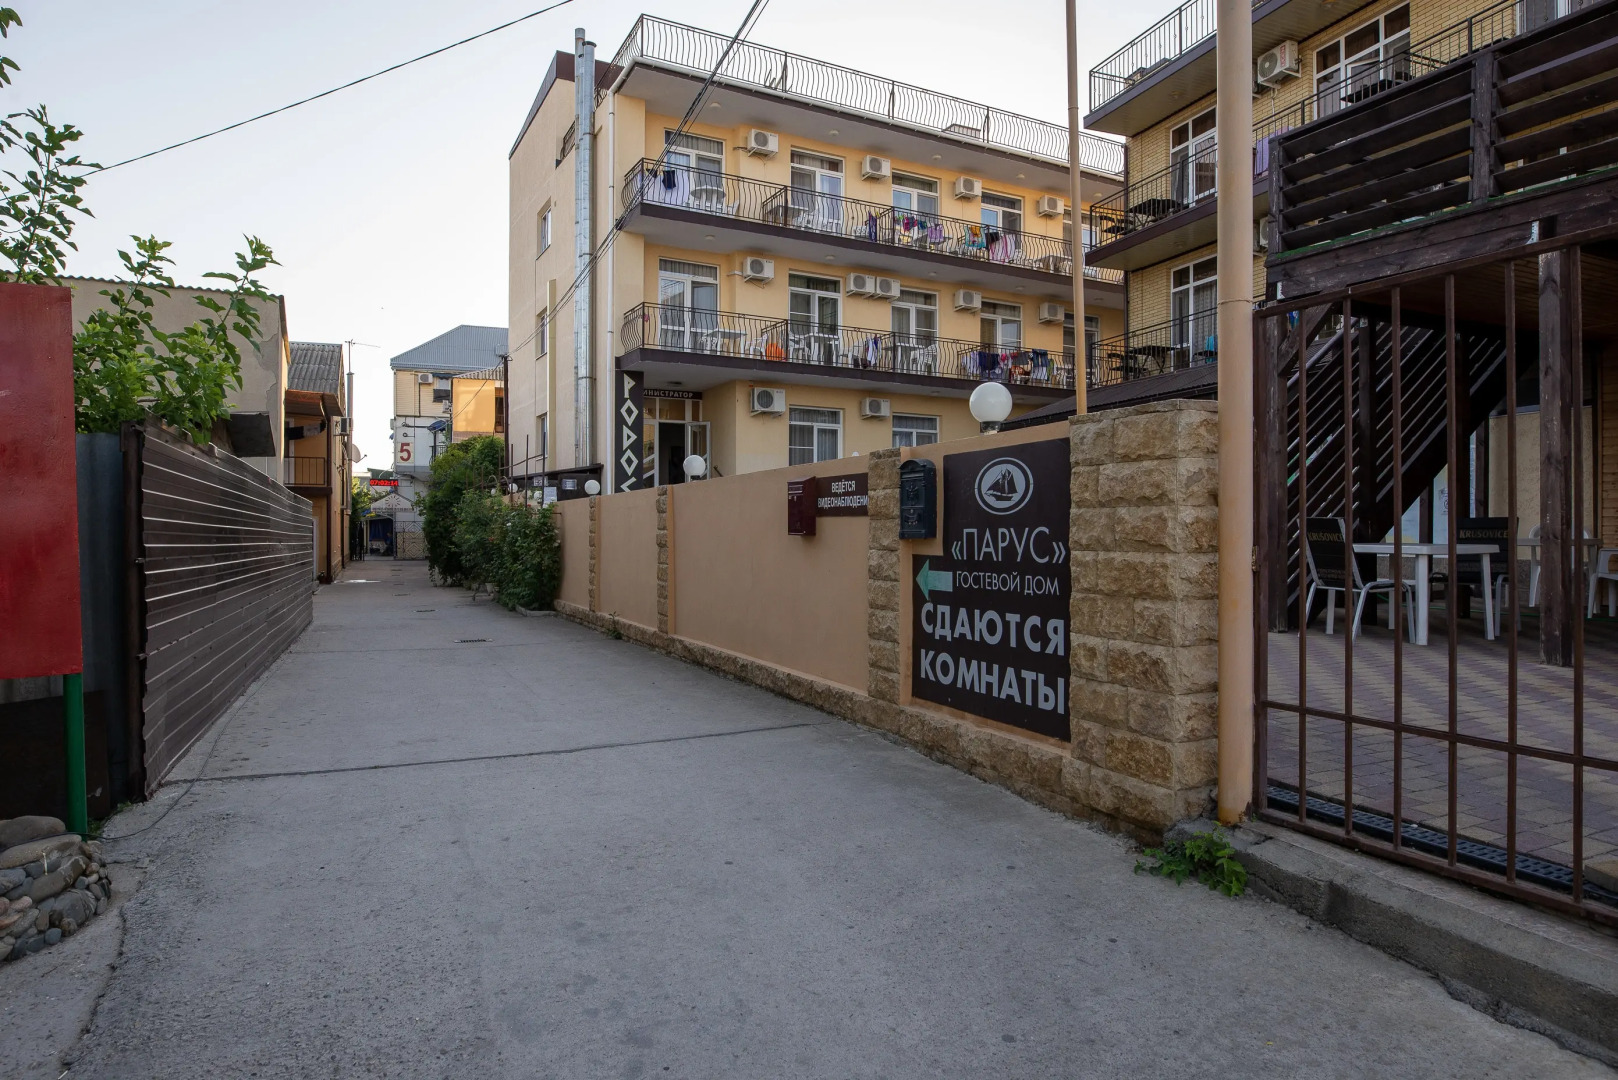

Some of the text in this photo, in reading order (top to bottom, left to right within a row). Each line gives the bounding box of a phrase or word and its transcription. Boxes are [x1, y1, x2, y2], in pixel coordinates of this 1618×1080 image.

[400, 443, 411, 462] 5
[831, 480, 856, 494] ВЕДЁТСЯ
[951, 526, 1067, 564] «ПАРУС»
[956, 570, 1060, 596] ГОСТЕВОЙ ДОМ
[920, 602, 1065, 657] СДАЮТСЯ
[920, 648, 1065, 715] КОМНАТЫ
